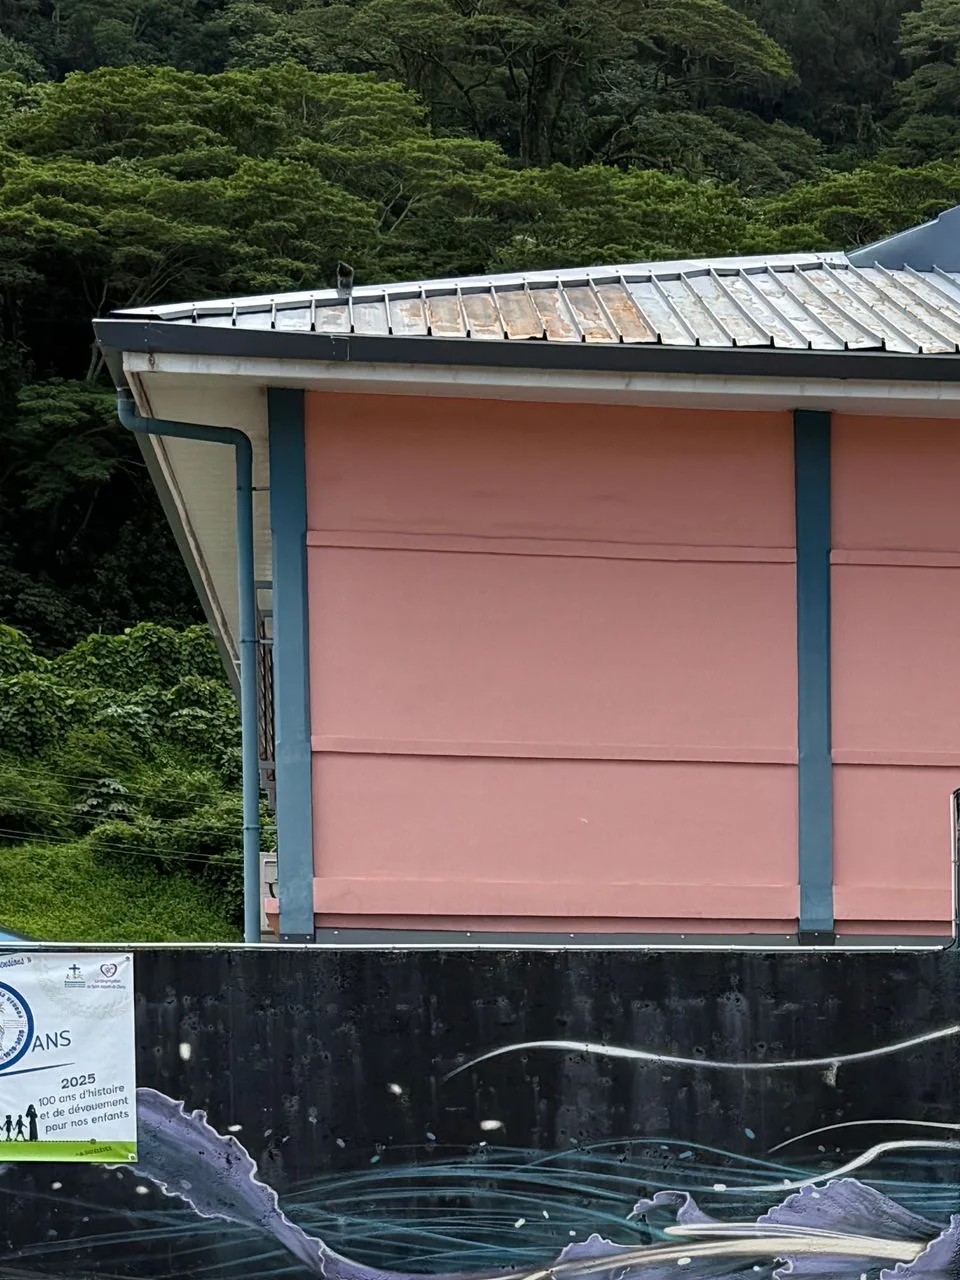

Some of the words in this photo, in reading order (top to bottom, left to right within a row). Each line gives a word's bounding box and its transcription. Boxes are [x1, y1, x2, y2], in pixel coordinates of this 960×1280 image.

[31, 1030, 72, 1053] ANS
[61, 1073, 96, 1090] 2025
[38, 1095, 56, 1107] 100
[58, 1093, 77, 1104] ans
[79, 1084, 125, 1100] d'histoire
[39, 1111, 50, 1121] et
[52, 1107, 65, 1118] de
[68, 1096, 129, 1115] dévouement
[45, 1121, 68, 1134] pour
[71, 1117, 89, 1127] nos
[91, 1110, 130, 1124] enfants
